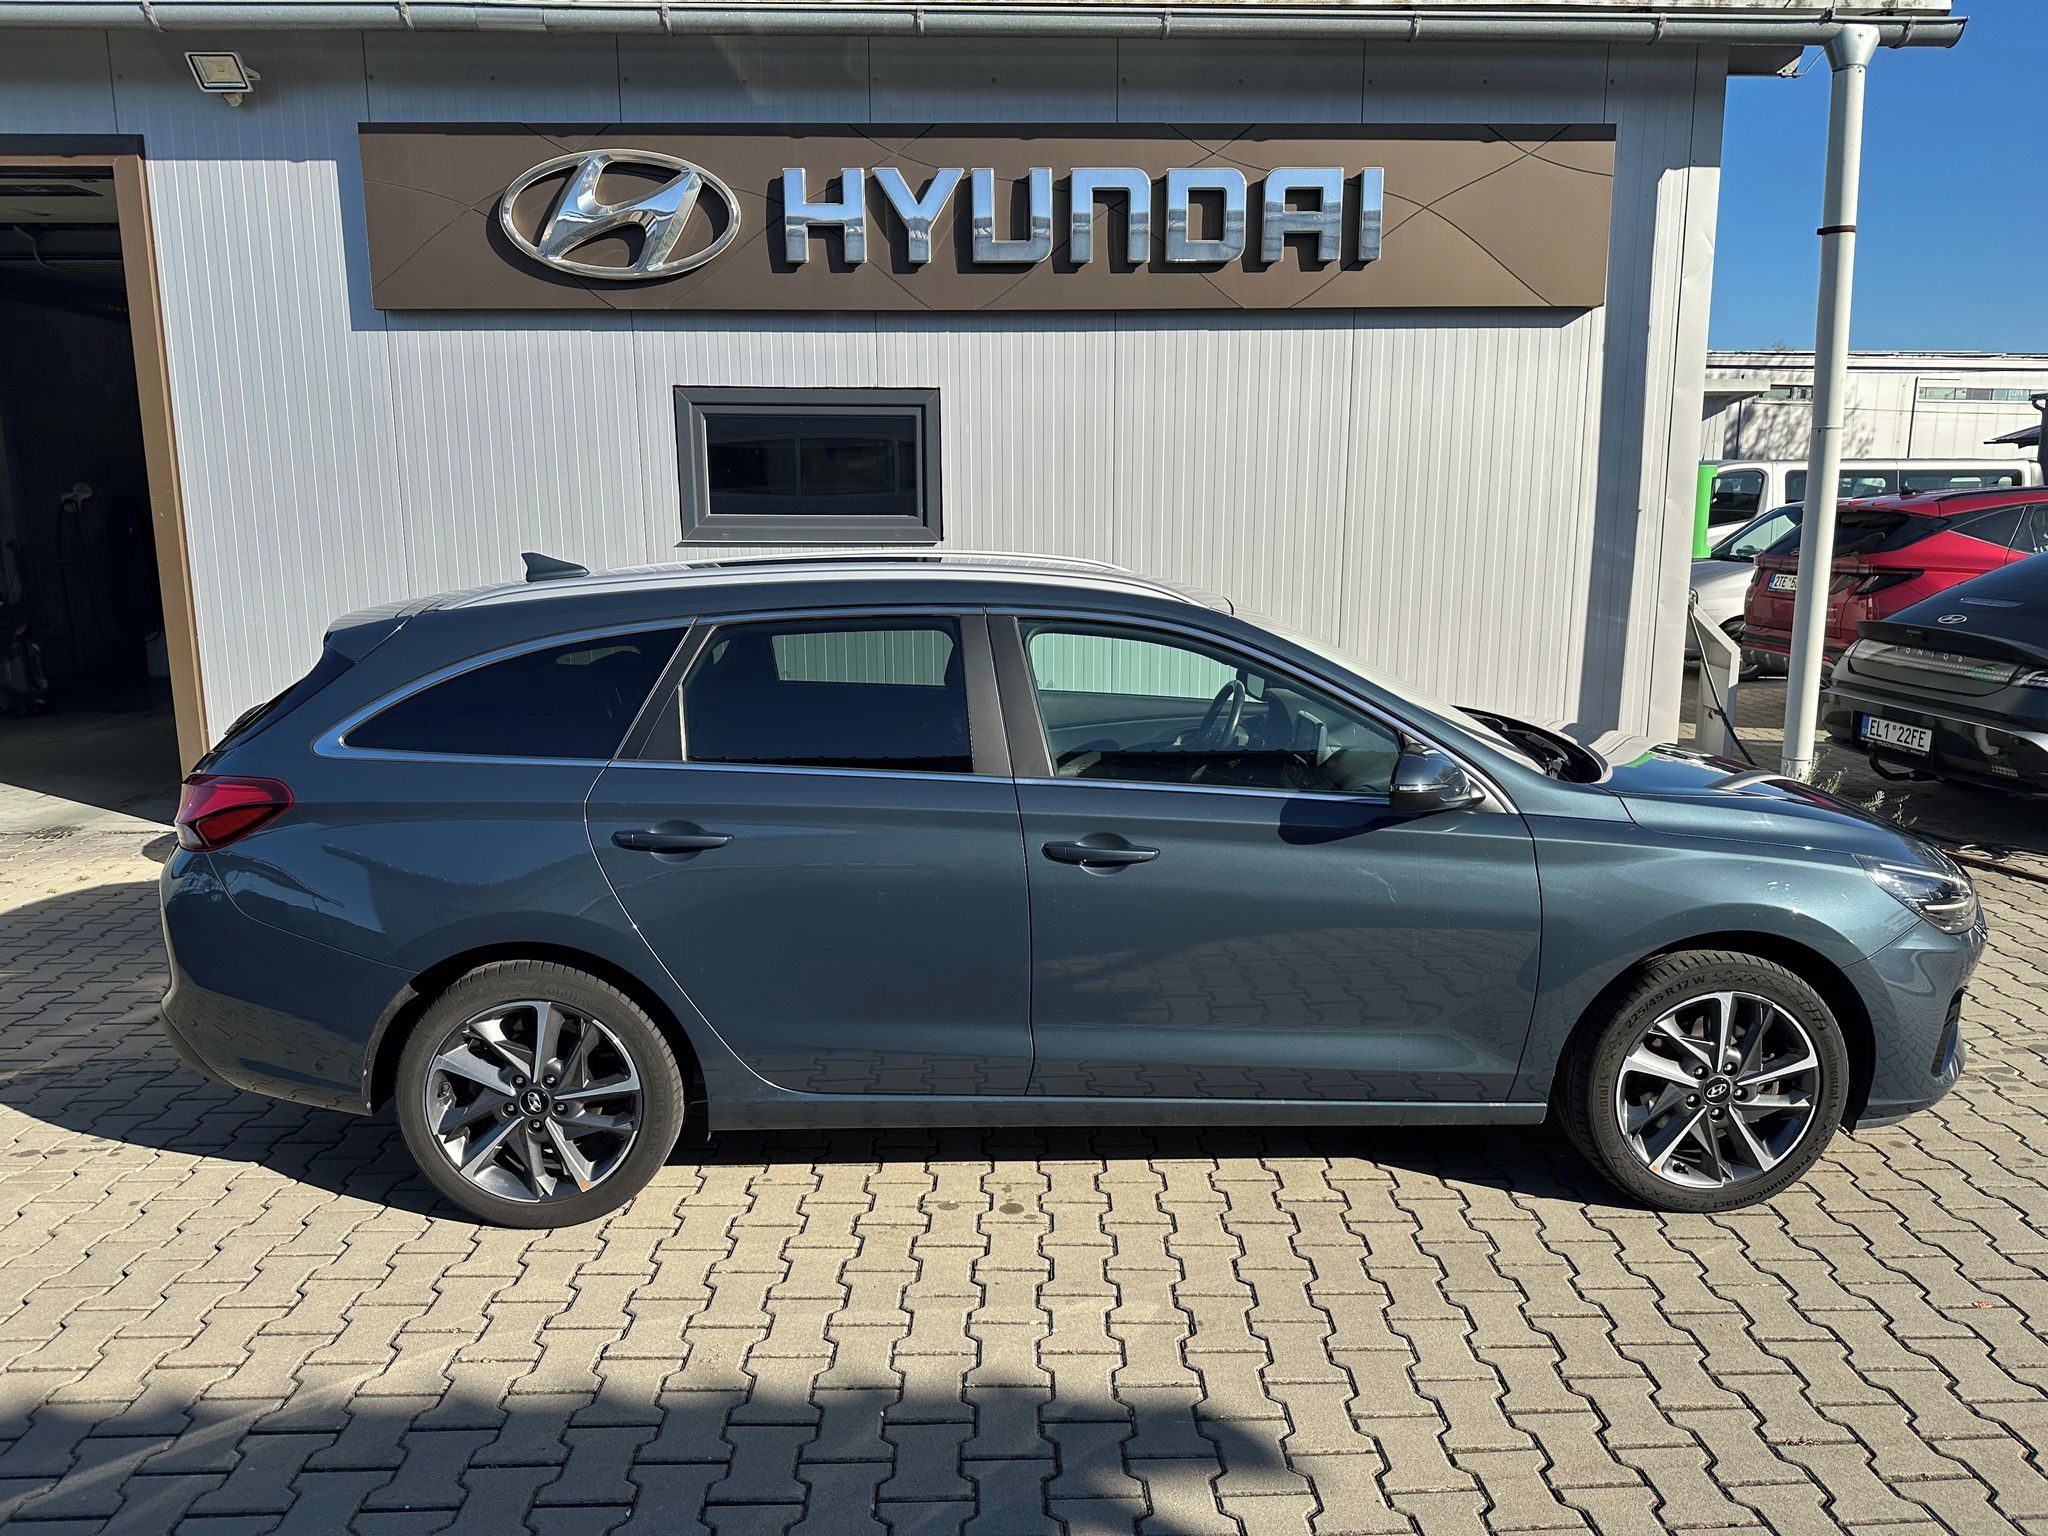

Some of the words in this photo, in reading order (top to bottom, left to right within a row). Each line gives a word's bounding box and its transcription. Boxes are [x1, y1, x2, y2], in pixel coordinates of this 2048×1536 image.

[781, 167, 1384, 266] HYUNDAI
[1897, 726, 1926, 748] 22FE
[1625, 993, 1664, 1029] 225/45
[1665, 987, 1675, 997] R
[1676, 980, 1689, 990] 17
[1693, 975, 1705, 984] W
